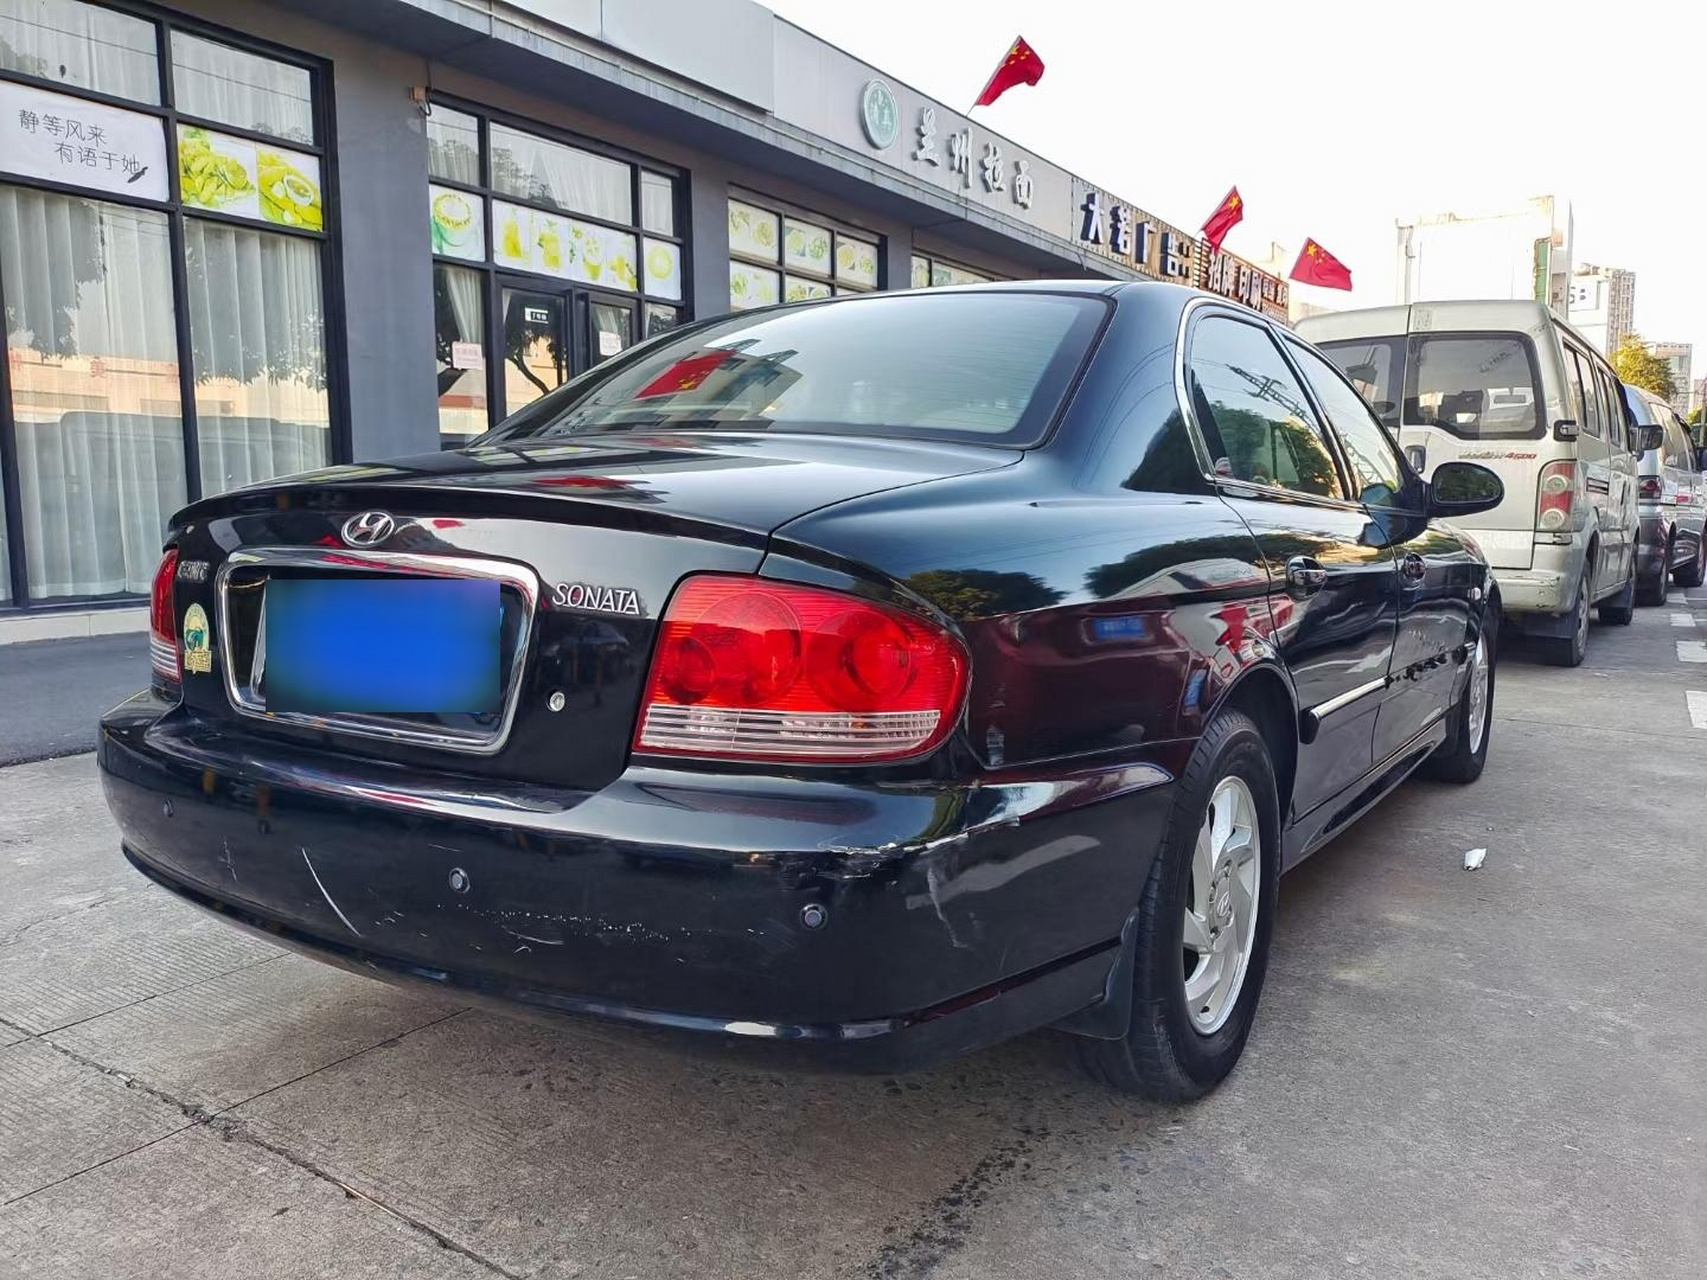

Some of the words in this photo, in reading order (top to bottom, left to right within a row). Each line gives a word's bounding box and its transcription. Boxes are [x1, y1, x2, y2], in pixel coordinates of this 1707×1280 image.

[19, 109, 107, 148] 静等风来
[54, 141, 141, 175] 有语于她
[913, 106, 1034, 210] 兰州拉面
[552, 583, 640, 615] SONATA
